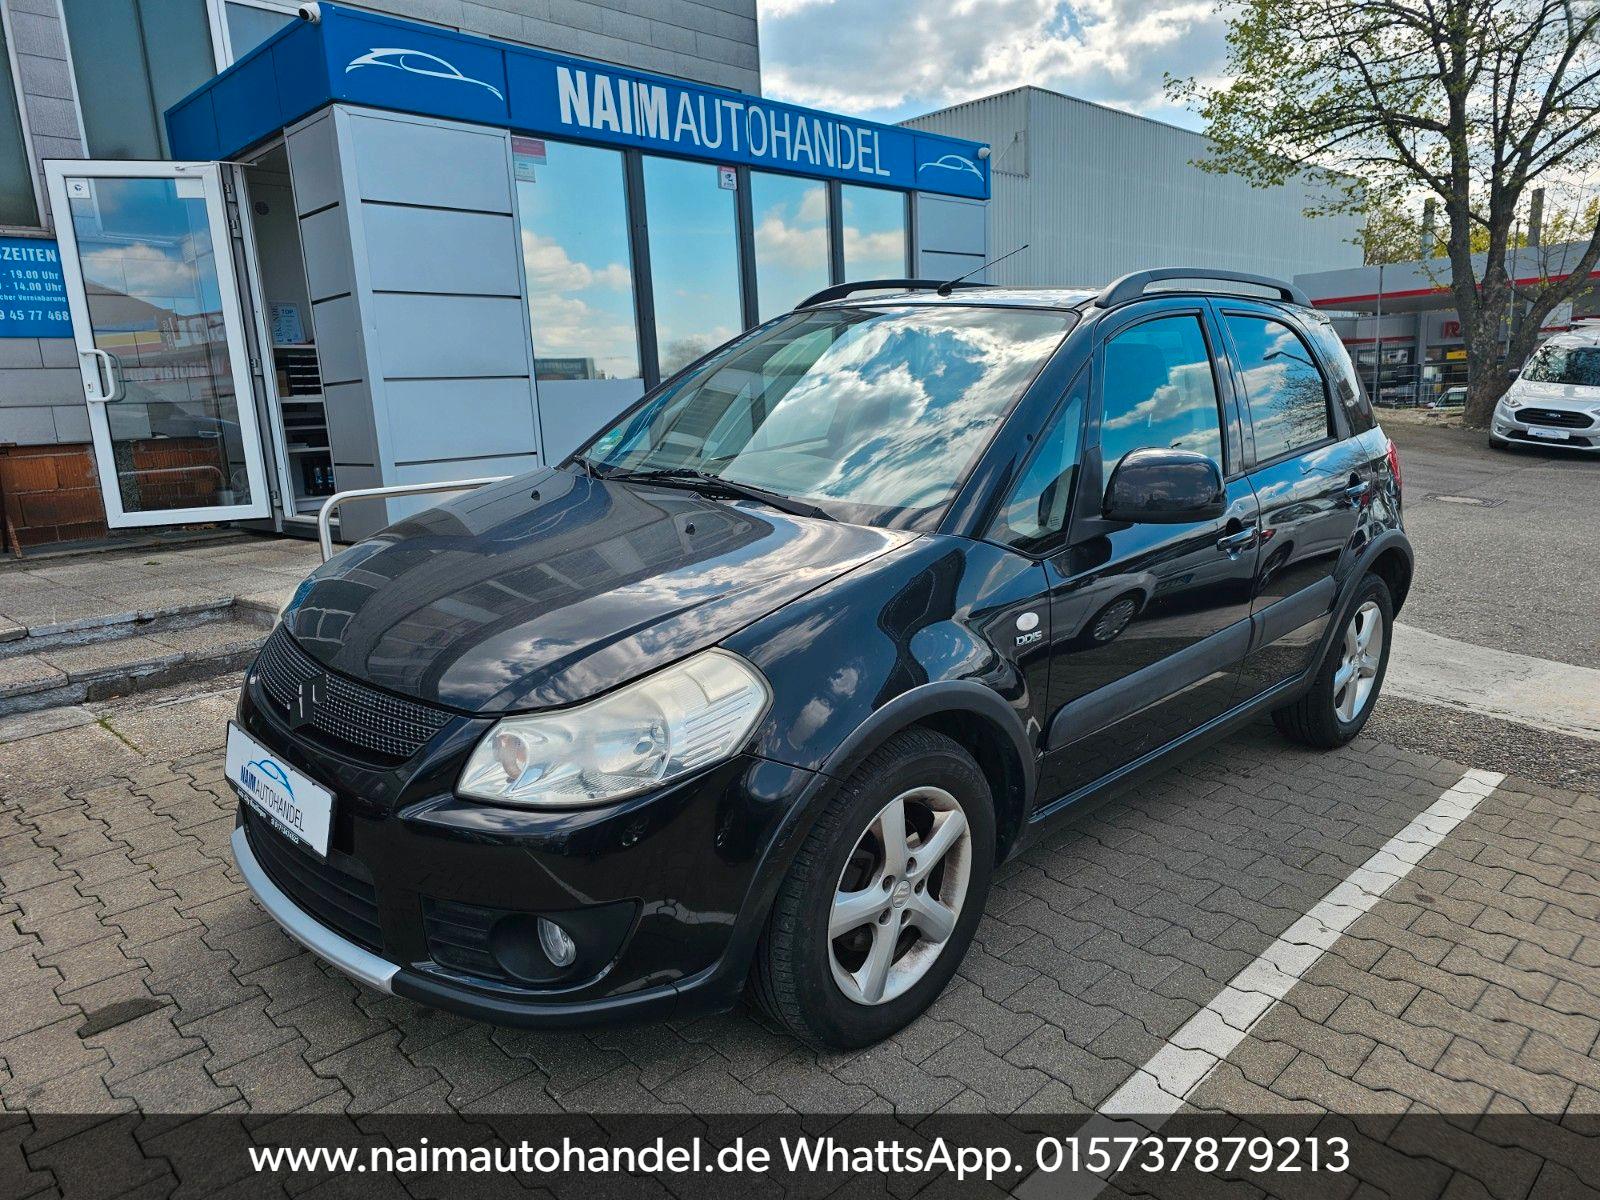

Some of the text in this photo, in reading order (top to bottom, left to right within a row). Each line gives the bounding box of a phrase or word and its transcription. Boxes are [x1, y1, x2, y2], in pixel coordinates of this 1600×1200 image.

[0, 246, 57, 262] ZEITEN
[10, 269, 39, 279] 19.00
[41, 270, 59, 280] Uhr
[13, 281, 42, 291] 14.00
[44, 282, 62, 292] Uhr
[10, 309, 25, 321] 45
[28, 310, 43, 321] 77
[47, 310, 69, 321] 468
